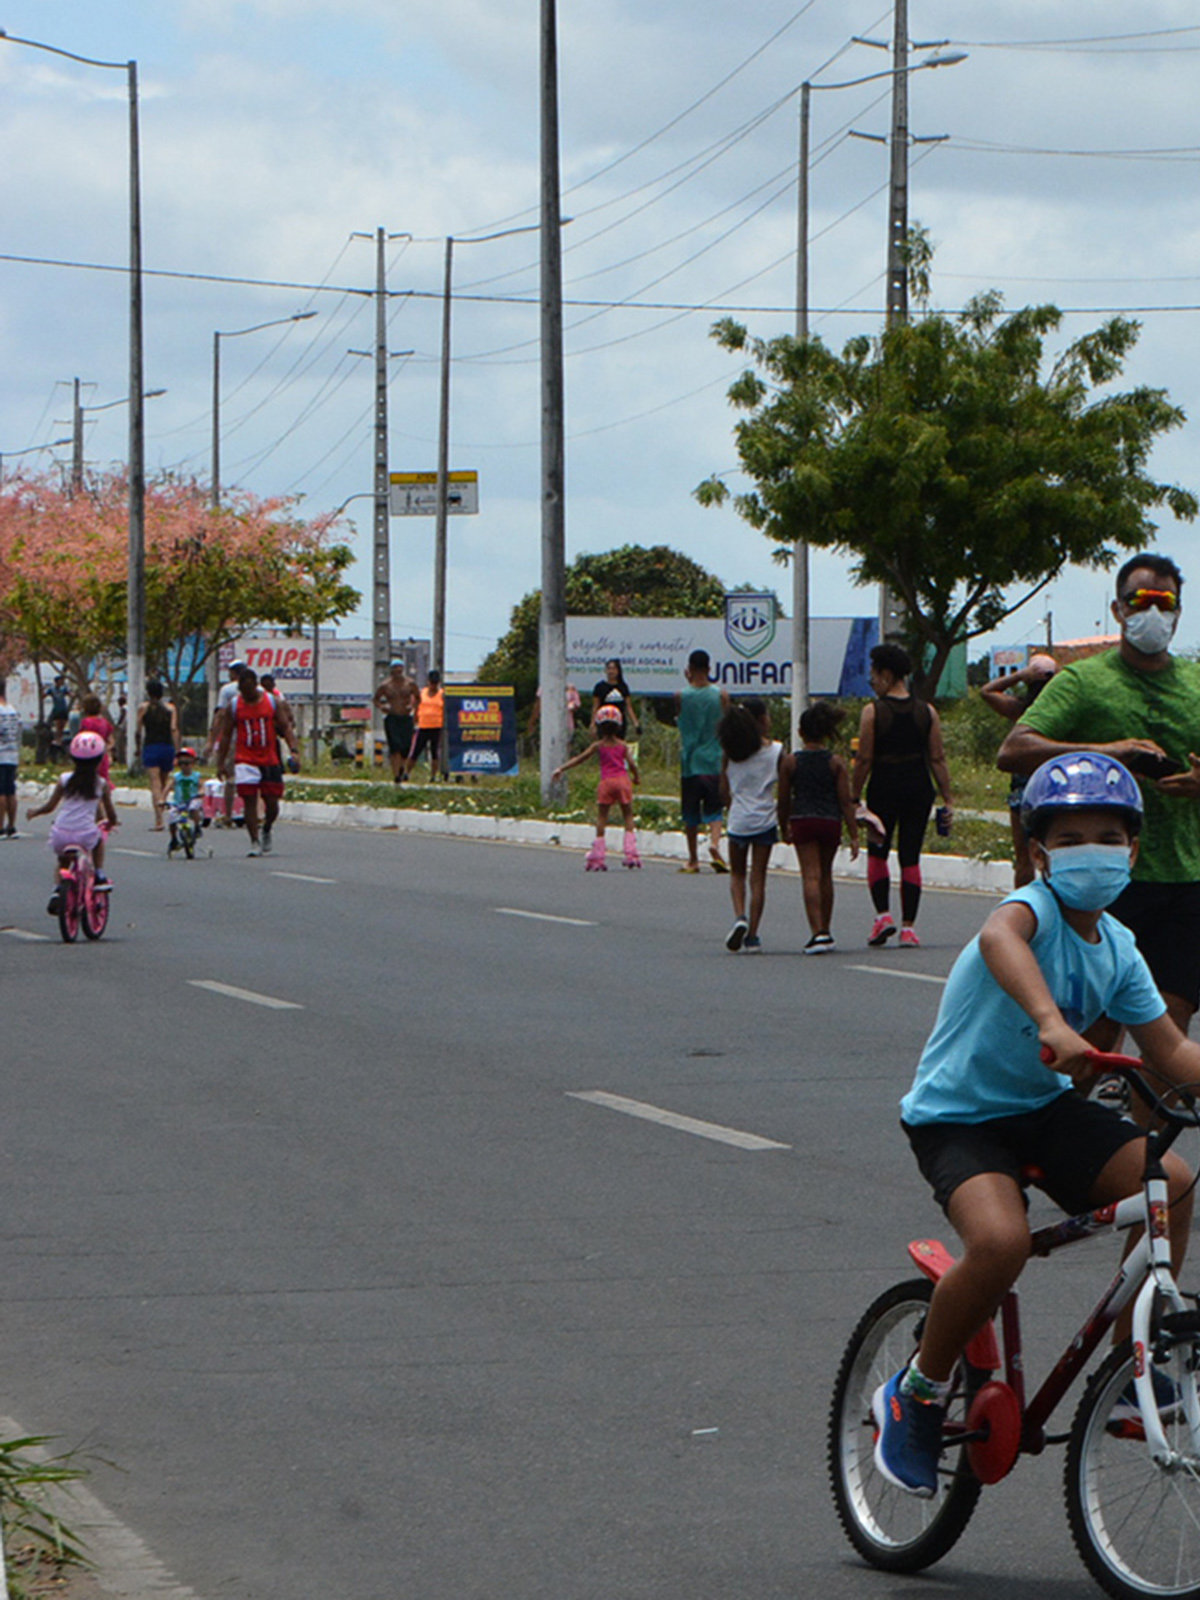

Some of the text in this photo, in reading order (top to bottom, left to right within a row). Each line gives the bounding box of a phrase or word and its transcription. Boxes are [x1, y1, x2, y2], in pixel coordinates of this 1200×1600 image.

[245, 648, 319, 667] TAIPE
[463, 699, 485, 711] DIA
[461, 712, 498, 723] LAZER
[463, 752, 500, 763] FEIRA
